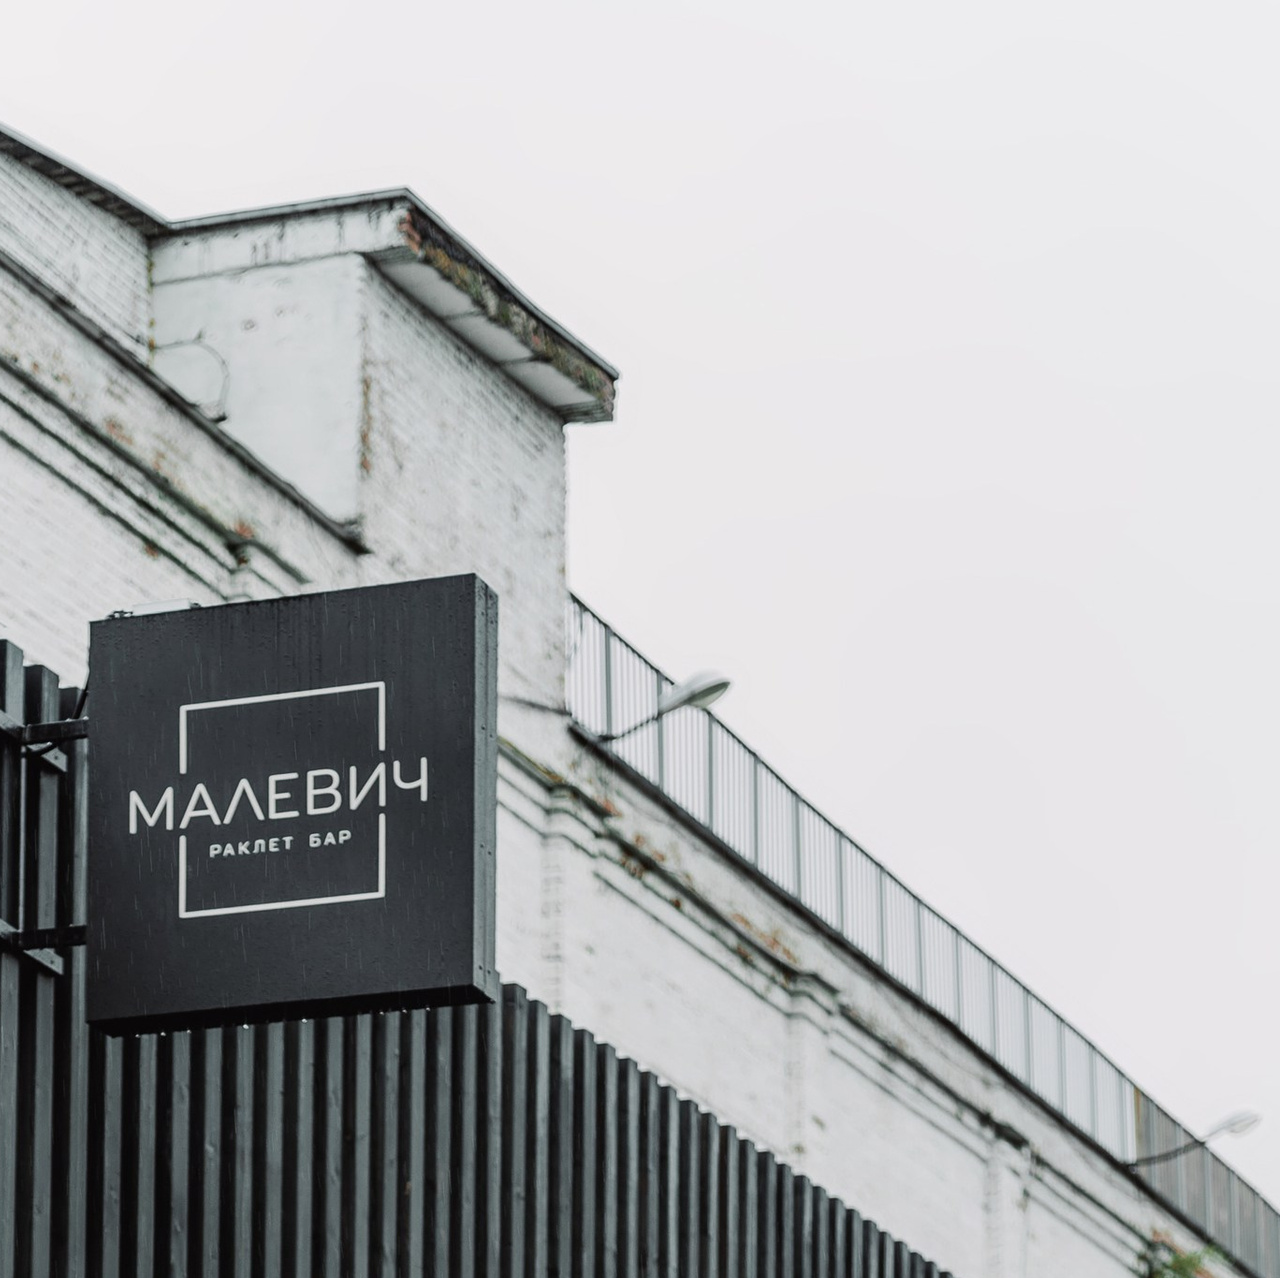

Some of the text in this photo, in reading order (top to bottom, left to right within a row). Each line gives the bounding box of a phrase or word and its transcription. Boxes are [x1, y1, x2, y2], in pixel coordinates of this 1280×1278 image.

[129, 757, 428, 834] МАЛЕВИЧ
[209, 830, 352, 858] РАКЛЕТ БАР
